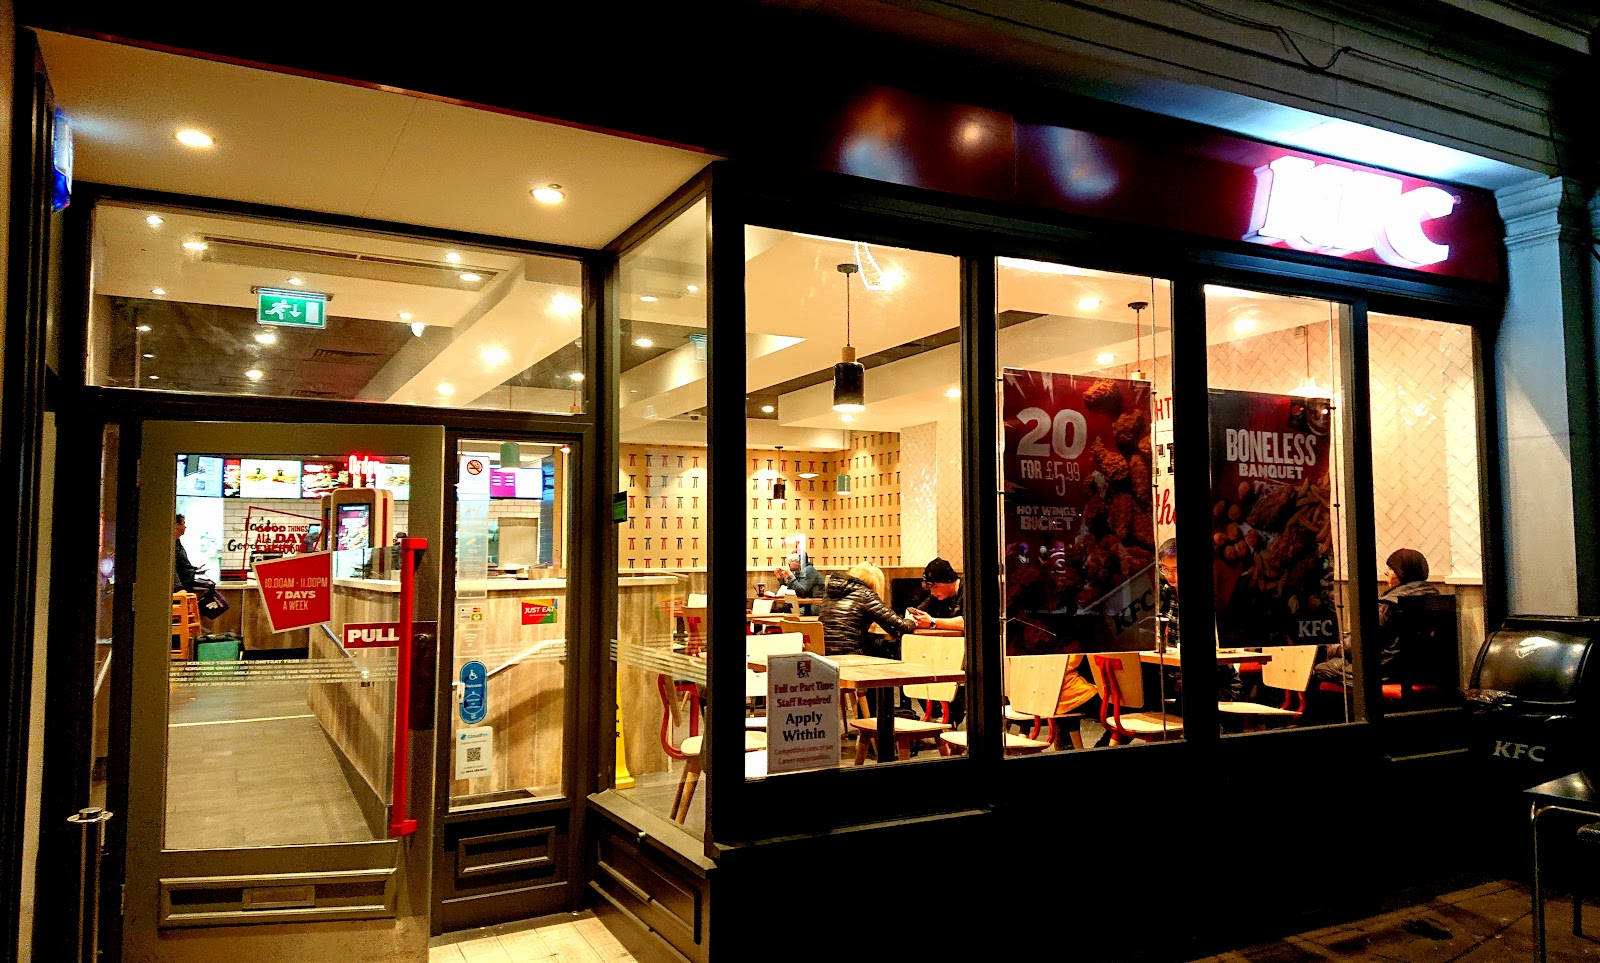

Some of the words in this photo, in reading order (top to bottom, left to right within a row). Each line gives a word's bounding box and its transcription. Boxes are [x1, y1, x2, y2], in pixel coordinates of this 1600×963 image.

[1016, 406, 1088, 460] 20
[1225, 428, 1317, 467] BONELESS
[1021, 460, 1042, 480] FOR
[1239, 463, 1304, 480] BANQUET
[1016, 505, 1039, 515] HOT
[1041, 506, 1077, 517] WINGS
[287, 525, 309, 533] THINGS
[1020, 516, 1074, 531] BUCKET
[256, 533, 271, 544] ALL
[274, 533, 309, 544] DAY
[275, 591, 284, 600] 7
[285, 590, 317, 599] DAYS
[282, 600, 288, 611] A
[289, 600, 309, 611] WEEK
[524, 606, 542, 614] JUST
[1111, 588, 1156, 637] KFC
[347, 628, 400, 643] PULL
[1298, 619, 1333, 638] KFC
[774, 683, 788, 694] Full
[789, 685, 798, 693] or
[799, 682, 815, 692] Part
[816, 681, 835, 690] Time
[776, 698, 797, 708] Staff
[797, 695, 832, 708] Required
[785, 711, 823, 728] Apply
[782, 727, 826, 742] Within
[1492, 740, 1547, 763] KFC
